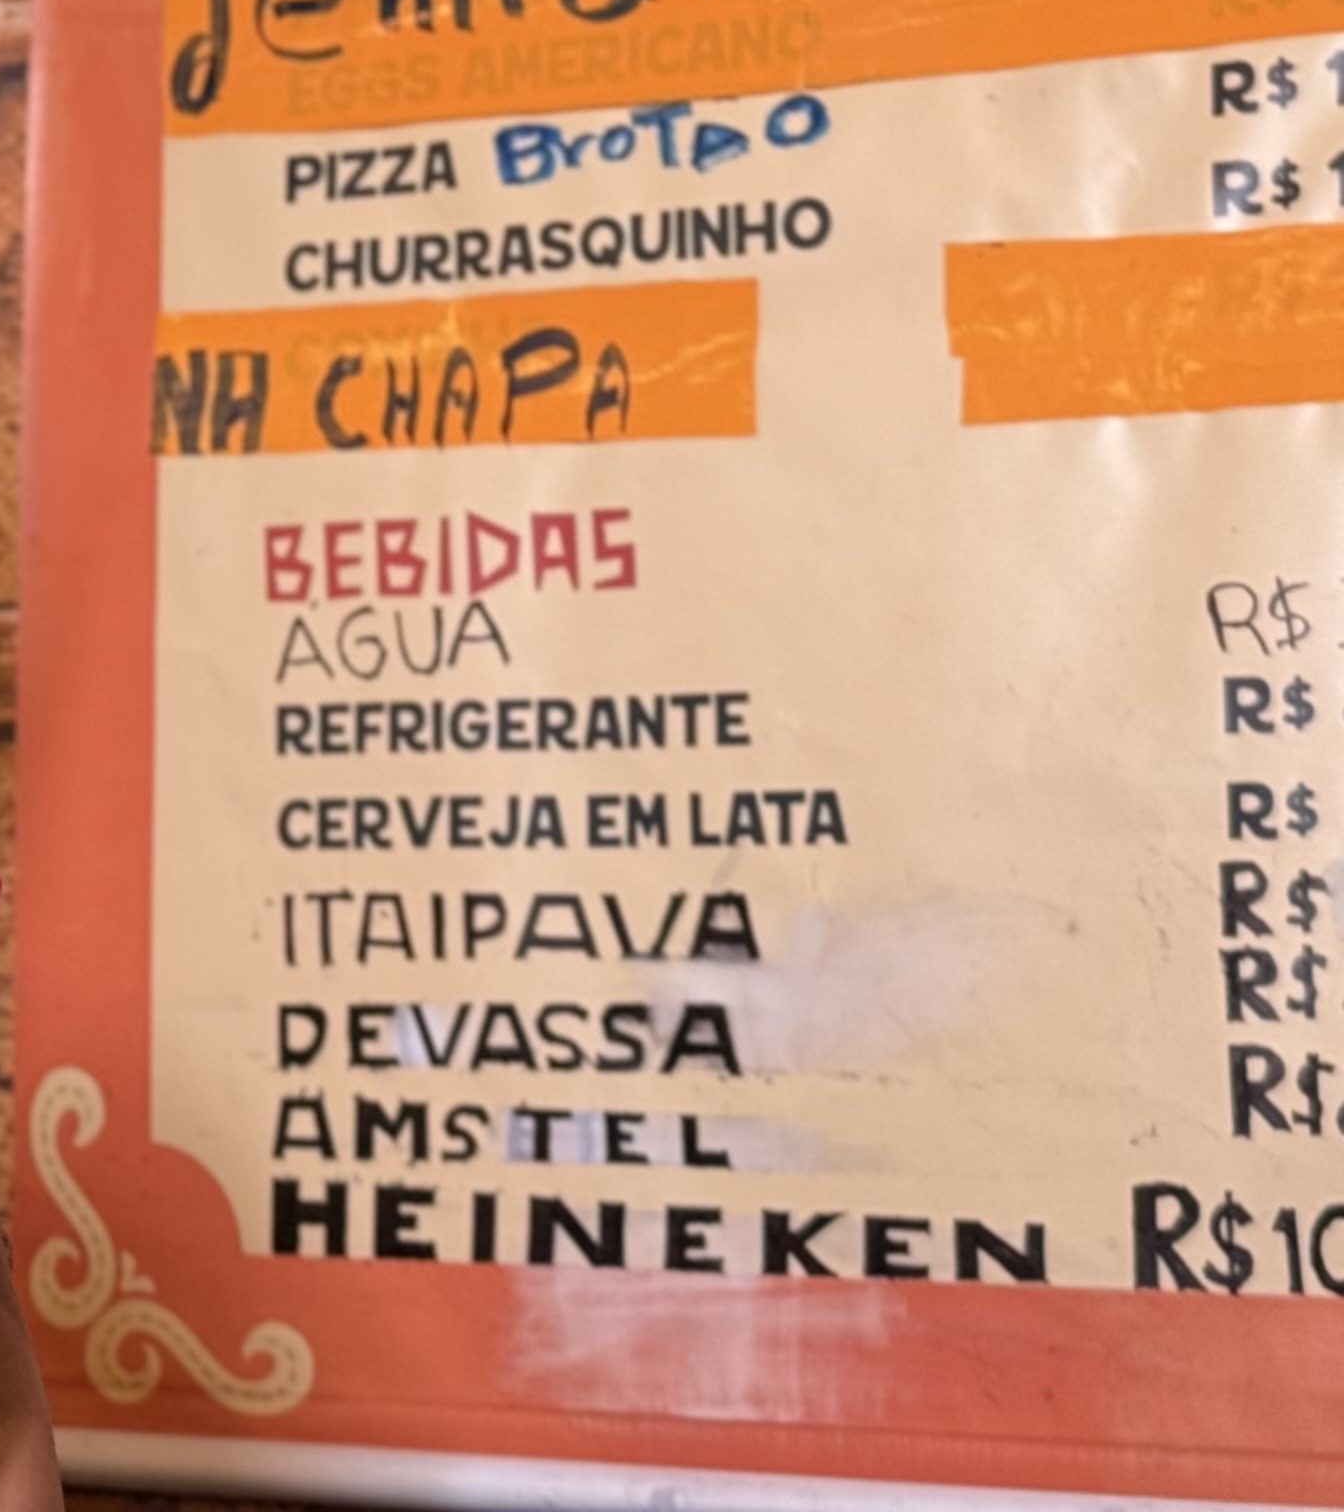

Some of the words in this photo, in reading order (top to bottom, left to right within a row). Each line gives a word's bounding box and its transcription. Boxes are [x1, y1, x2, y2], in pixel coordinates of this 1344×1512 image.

[1212, 57, 1298, 117] R$
[285, 142, 457, 203] PIZZA
[1213, 159, 1300, 217] R$
[285, 198, 830, 292] CHURRASQUINHO
[315, 327, 632, 453] CHAPA
[265, 507, 637, 602] BEBIDAS
[1206, 575, 1311, 656] R$
[276, 692, 751, 755] REFRIGERANTE
[1222, 675, 1315, 734] R$
[277, 793, 566, 849] CERVEJA
[586, 793, 669, 847] EM
[689, 790, 848, 846] LATA
[1226, 782, 1318, 840] R$
[283, 888, 760, 966] ITAIPAVA
[277, 1003, 742, 1075] DEVASSA
[272, 1094, 733, 1169] AMSTEL
[270, 1178, 1048, 1282] HEINEKEN
